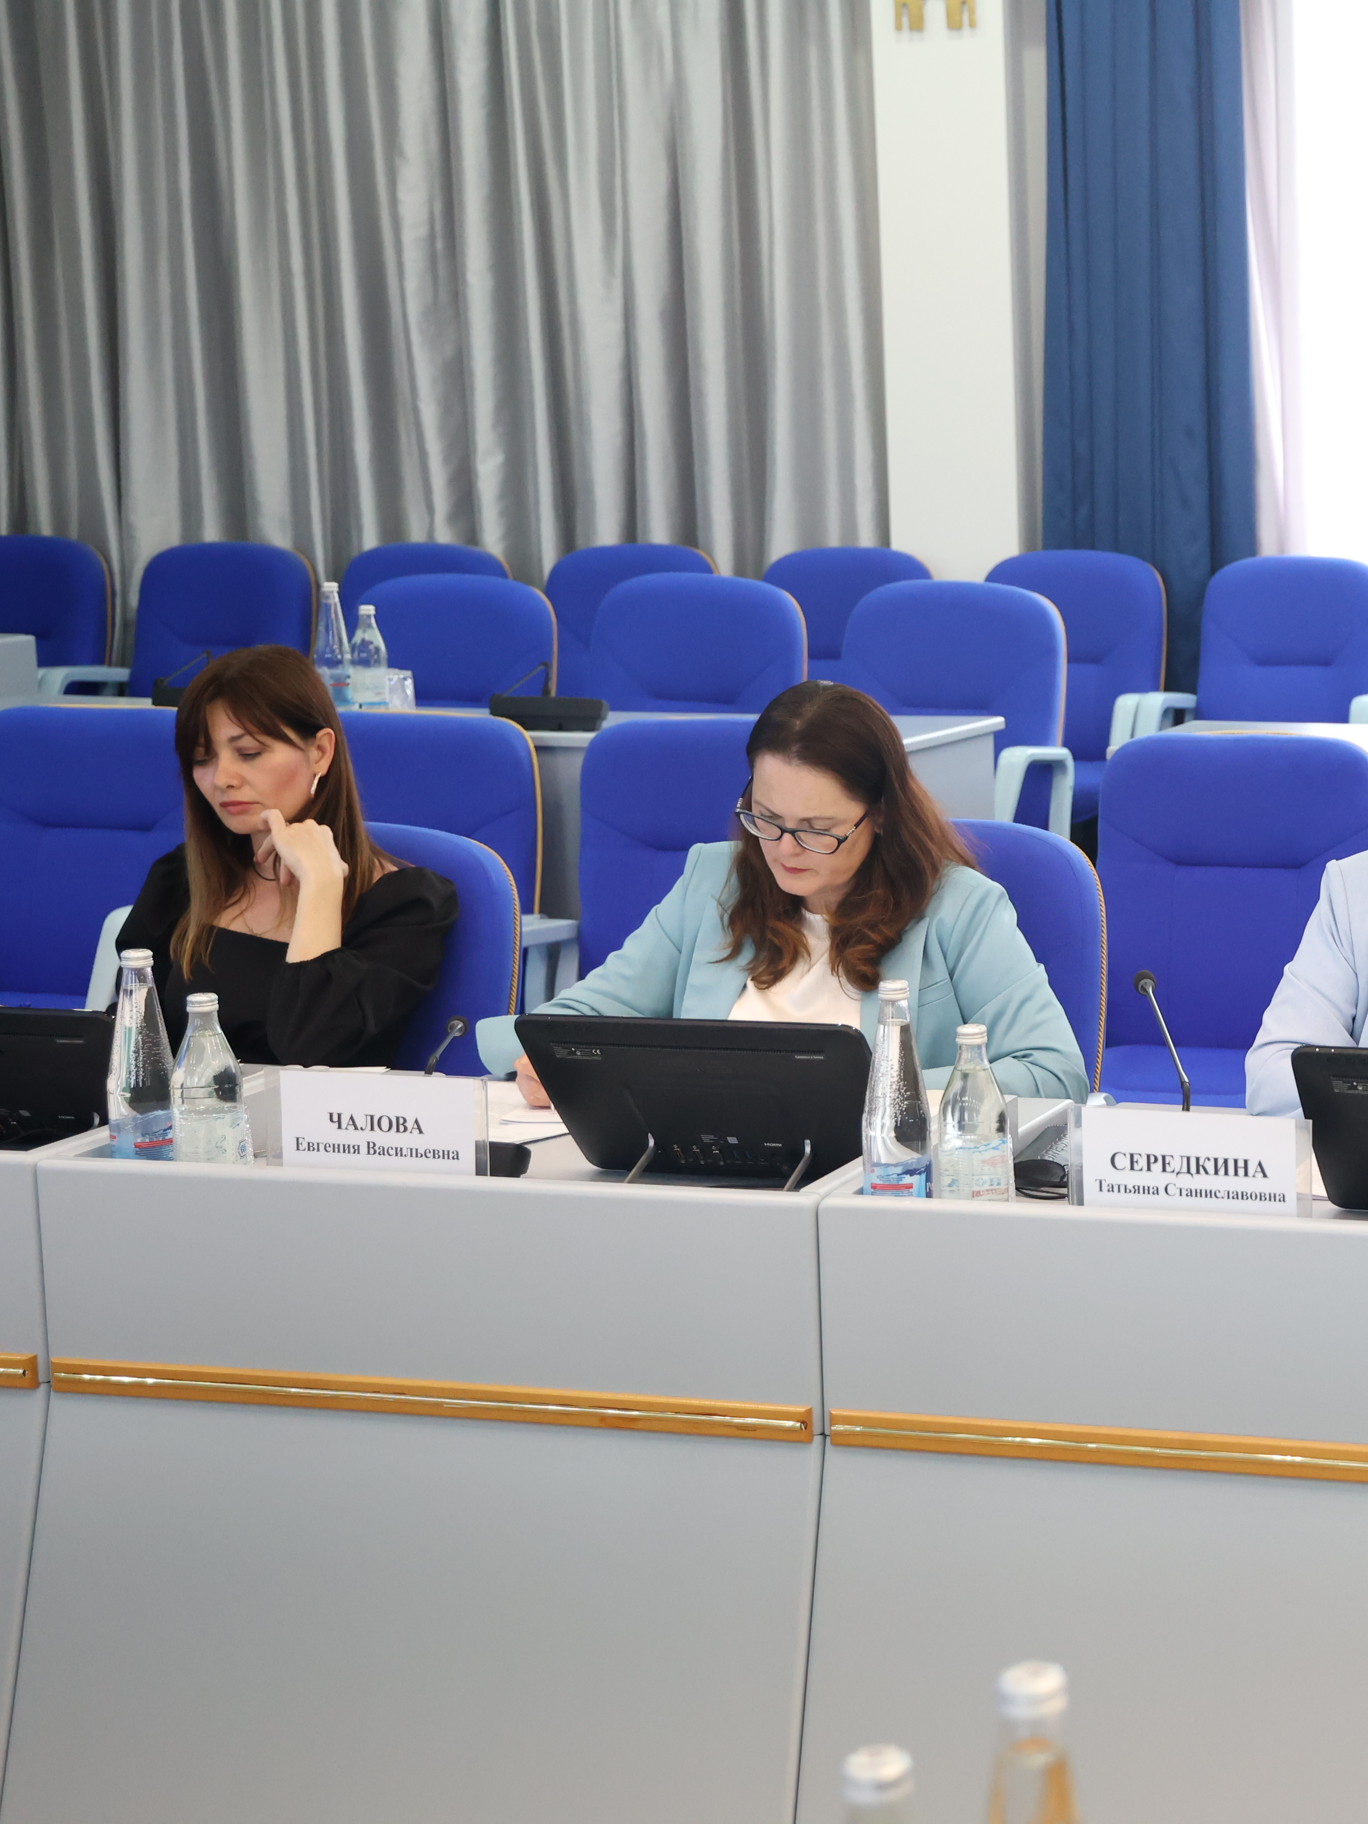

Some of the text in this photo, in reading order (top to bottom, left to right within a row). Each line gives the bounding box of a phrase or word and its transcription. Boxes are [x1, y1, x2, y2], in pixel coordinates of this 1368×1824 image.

[327, 1111, 425, 1135] ЧАЛОВА
[294, 1136, 460, 1161] Евгения Васильевна
[1109, 1151, 1269, 1179] СЕРЕДКИНА
[1094, 1178, 1287, 1203] Татьяна Станиславовна
